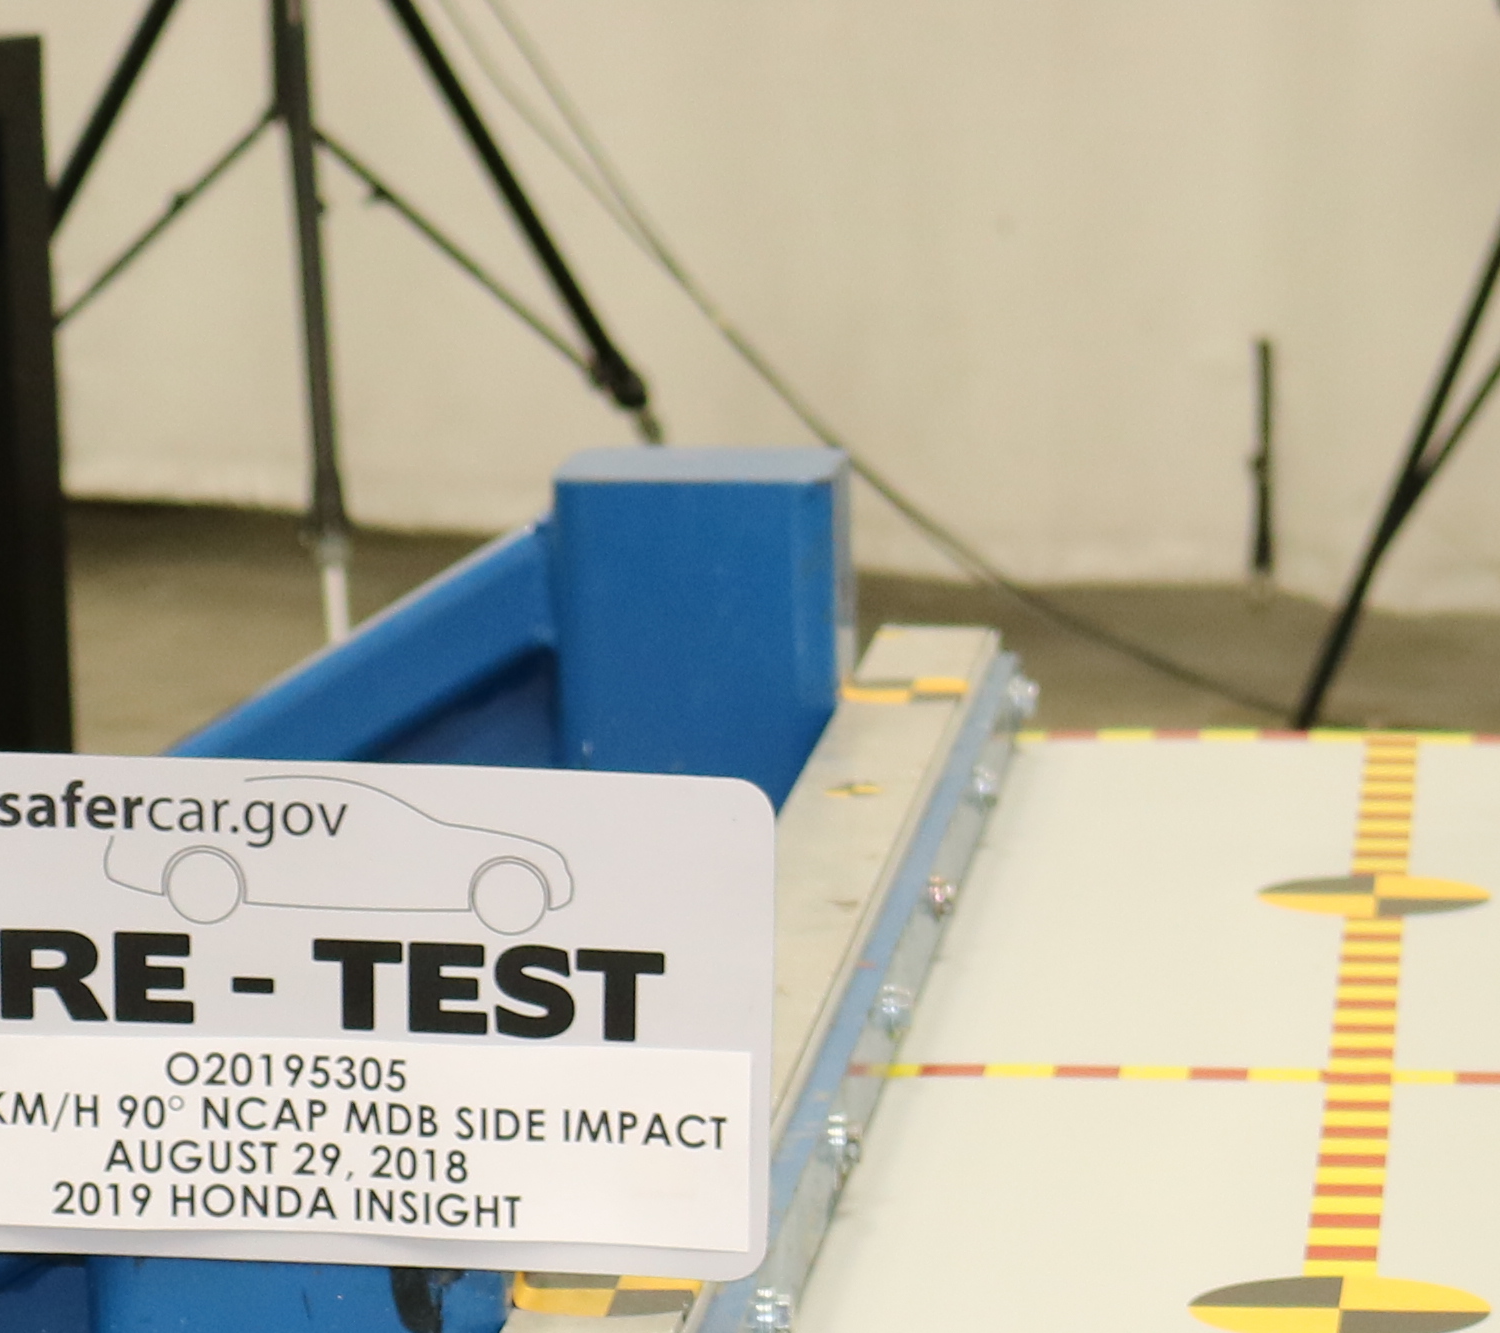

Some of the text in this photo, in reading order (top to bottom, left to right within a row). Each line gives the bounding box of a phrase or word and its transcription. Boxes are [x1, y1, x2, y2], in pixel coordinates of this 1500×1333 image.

[312, 938, 665, 1042] TEST
[202, 1096, 328, 1133] NCAP
[345, 1100, 439, 1138] MDB
[456, 1106, 545, 1142] SIDE
[564, 1110, 727, 1149] IMPACT
[105, 1139, 468, 1184] AUGUST 29, 2018
[54, 1181, 521, 1228] 2019 HONDA INSIGHT
